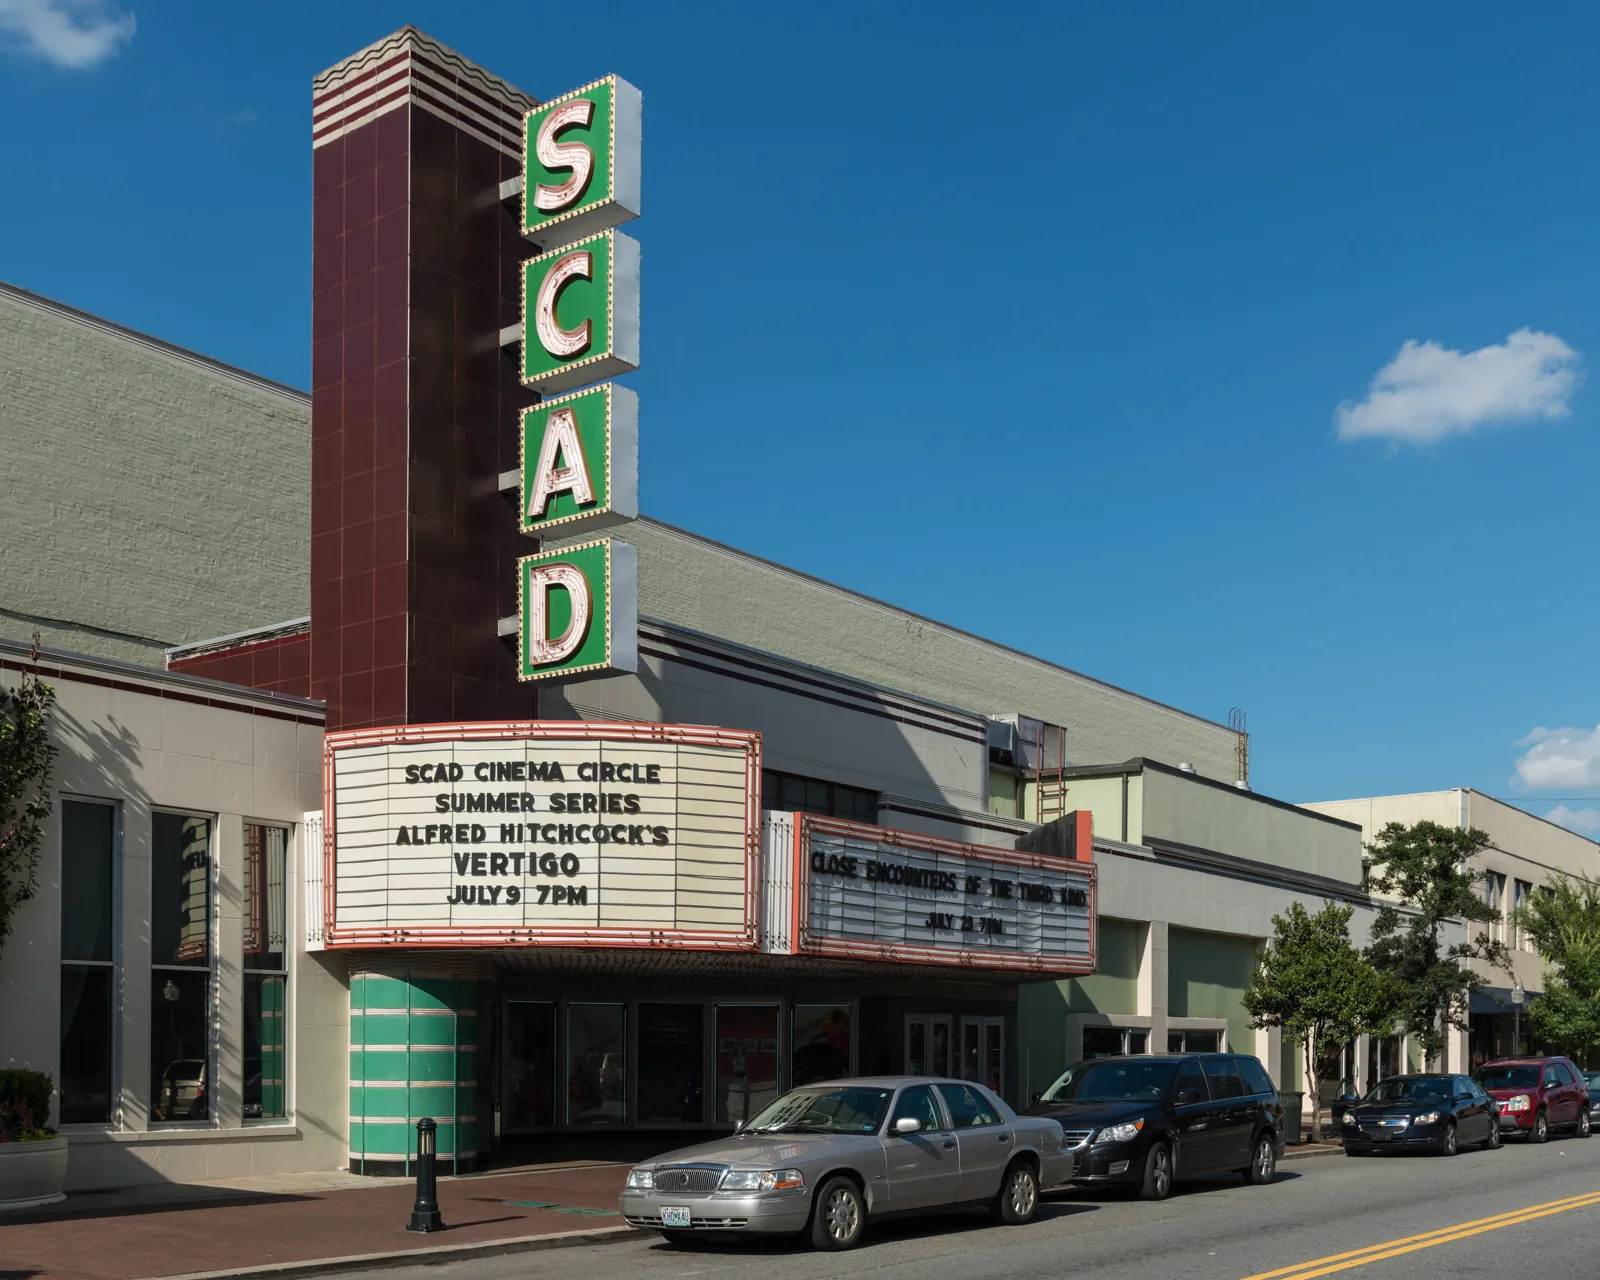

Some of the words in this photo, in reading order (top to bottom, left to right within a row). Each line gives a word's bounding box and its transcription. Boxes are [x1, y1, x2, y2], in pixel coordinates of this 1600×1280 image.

[527, 98, 597, 667] SCAD
[405, 762, 464, 785] SCAD
[474, 762, 565, 784] CINEMA
[576, 763, 661, 784] CIRCLE
[435, 793, 536, 814] SUMMER
[549, 793, 641, 814] SERIES
[396, 824, 486, 846] ALFRED
[500, 823, 669, 846] HITCHCOCK'S
[453, 852, 580, 877] VERTIGO
[811, 852, 858, 878] CLOSE
[866, 860, 957, 891] ENCOUNTERS
[965, 875, 982, 894] OF
[990, 878, 1013, 899] THE
[1019, 882, 1053, 903] THIRD
[1060, 887, 1086, 906] KIND
[447, 885, 502, 906] JULY
[505, 885, 521, 905] 9
[536, 885, 588, 906] 7PM
[925, 912, 953, 929] JULY
